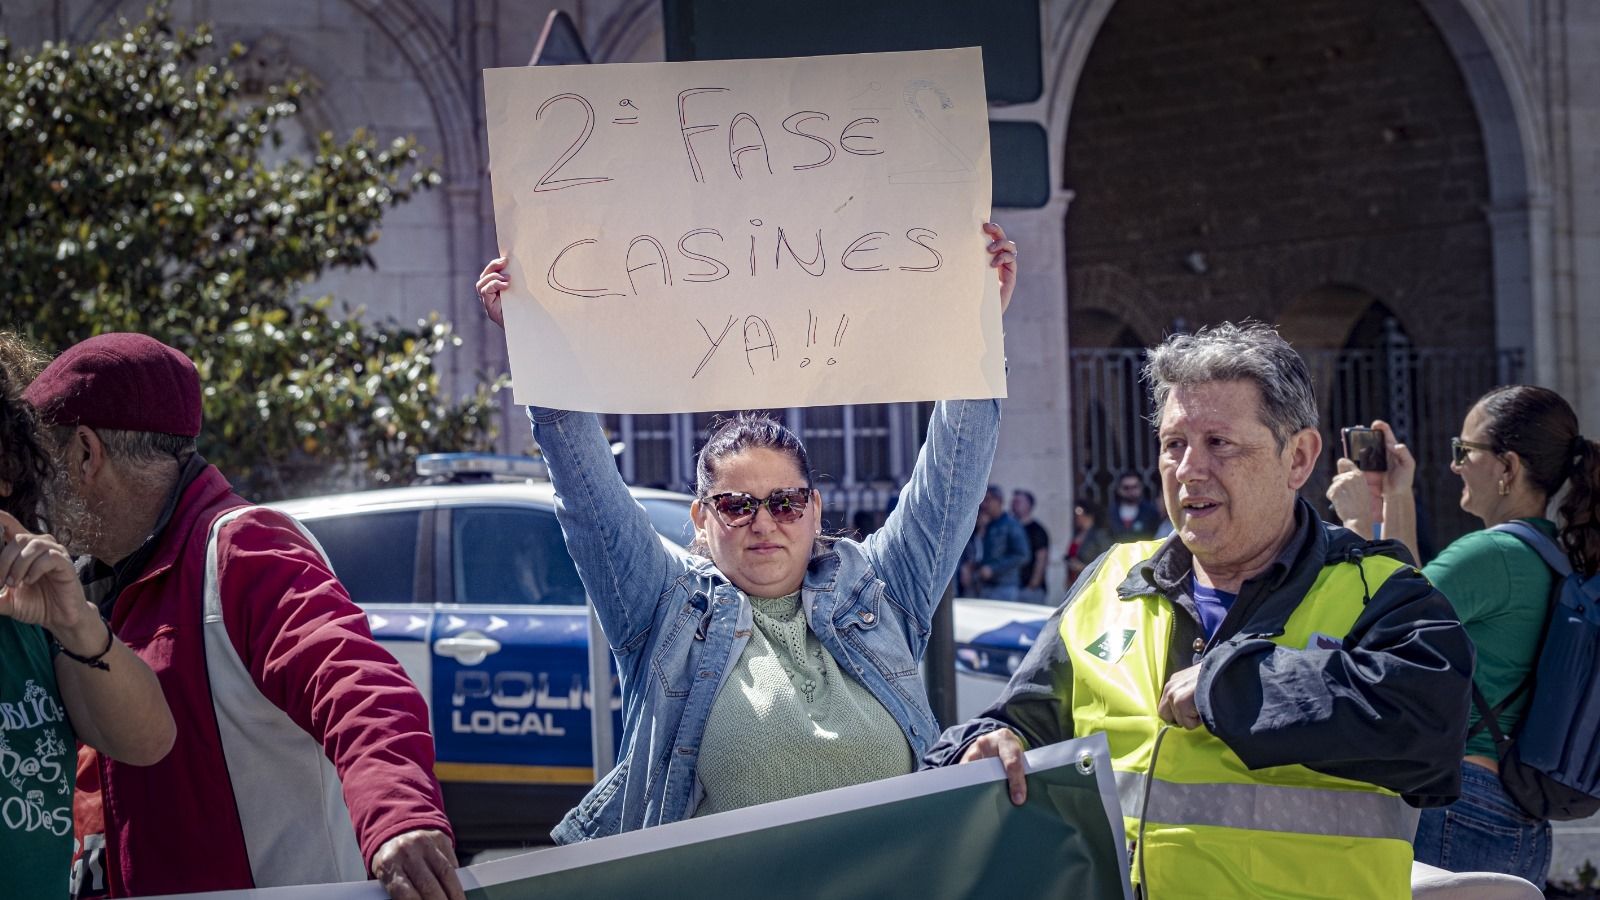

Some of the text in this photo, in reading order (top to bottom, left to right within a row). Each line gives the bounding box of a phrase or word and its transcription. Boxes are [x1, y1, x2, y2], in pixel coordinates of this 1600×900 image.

[677, 86, 885, 184] FASE
[692, 309, 850, 379] YA!!
[452, 711, 565, 736] LOCAL
[0, 796, 72, 836] OD@S
